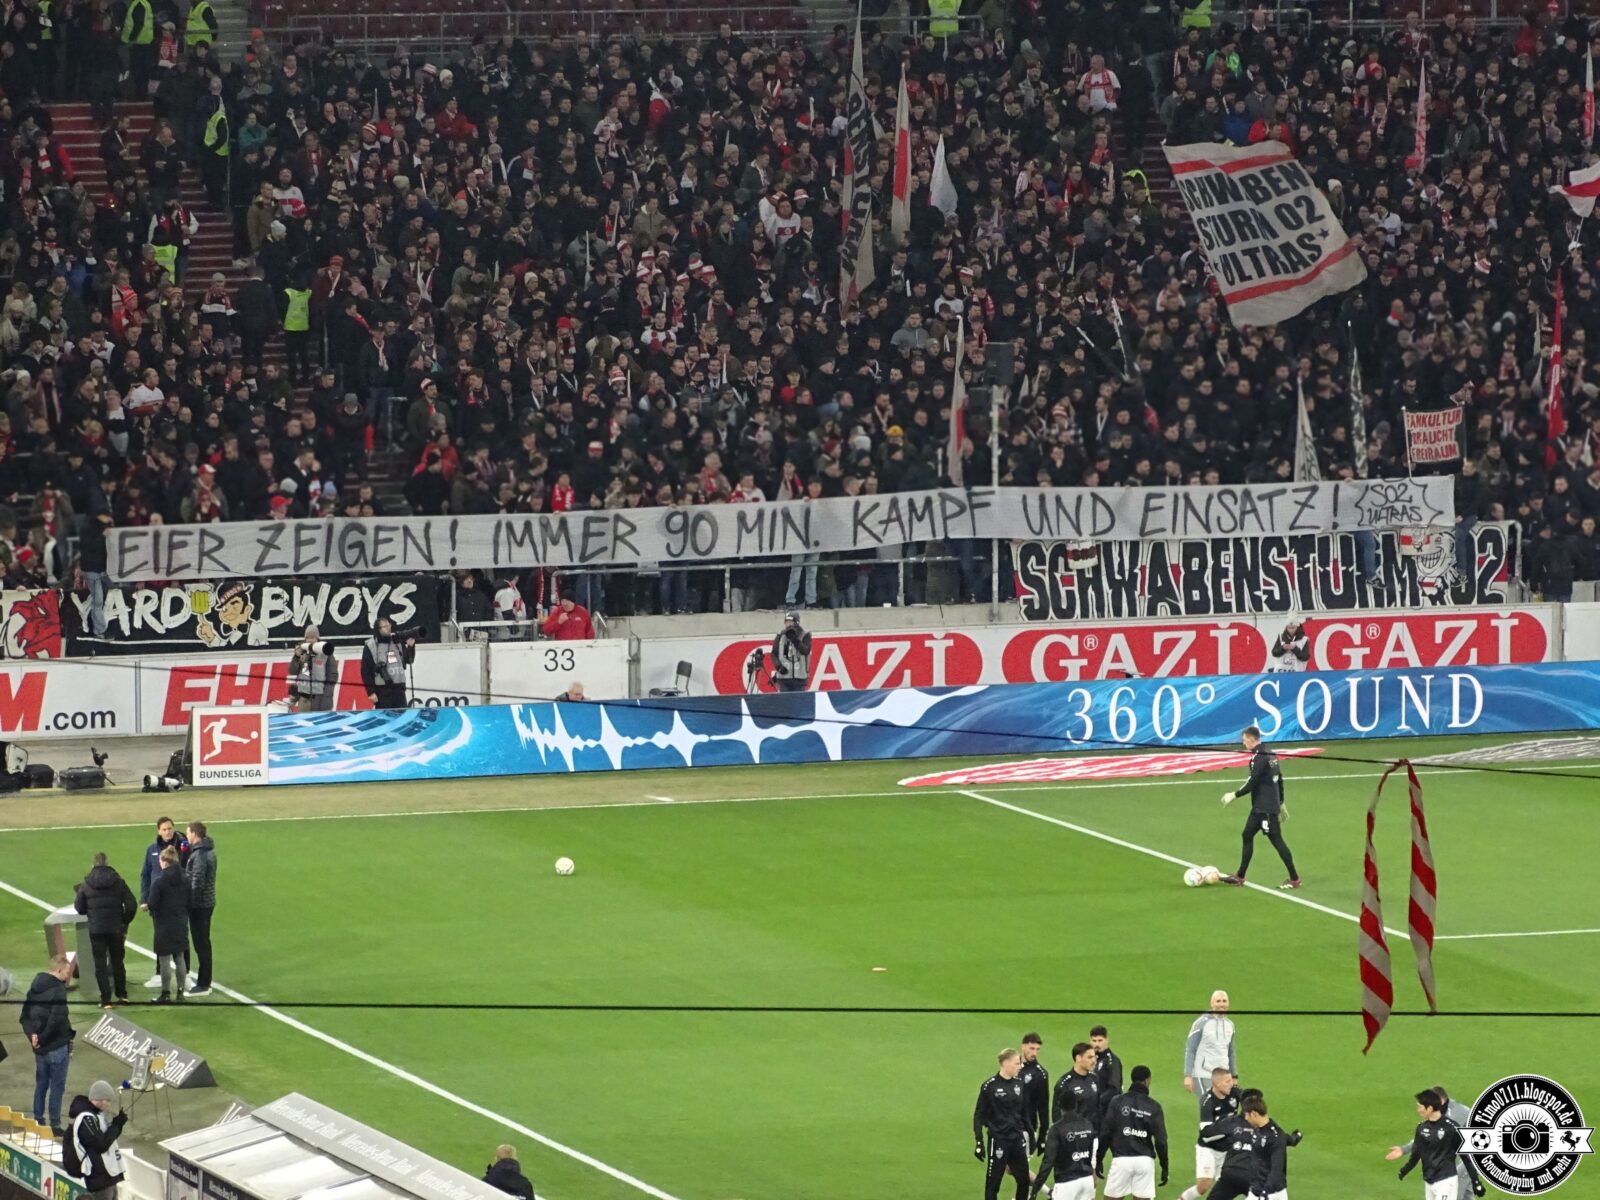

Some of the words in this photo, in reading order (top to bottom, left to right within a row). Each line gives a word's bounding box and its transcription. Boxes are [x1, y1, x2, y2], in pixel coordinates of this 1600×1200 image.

[1179, 162, 1310, 212] SCHWBEN
[1219, 232, 1323, 286] ULTRAS
[118, 527, 232, 578] EIER
[254, 519, 458, 572] ZEIGEN!
[493, 512, 641, 565] IMMER
[664, 508, 719, 558] 90
[736, 506, 821, 551] MIN.
[852, 488, 996, 547] KAMPF
[1023, 490, 1117, 538] UND
[1138, 482, 1340, 536] EINSATZ!
[70, 586, 192, 637] YARD
[259, 582, 418, 629] BWOYS
[544, 648, 576, 672] 33
[1065, 683, 1215, 744] 360°
[1253, 672, 1485, 737] SOUND
[199, 770, 262, 779] BUNDESLIGA
